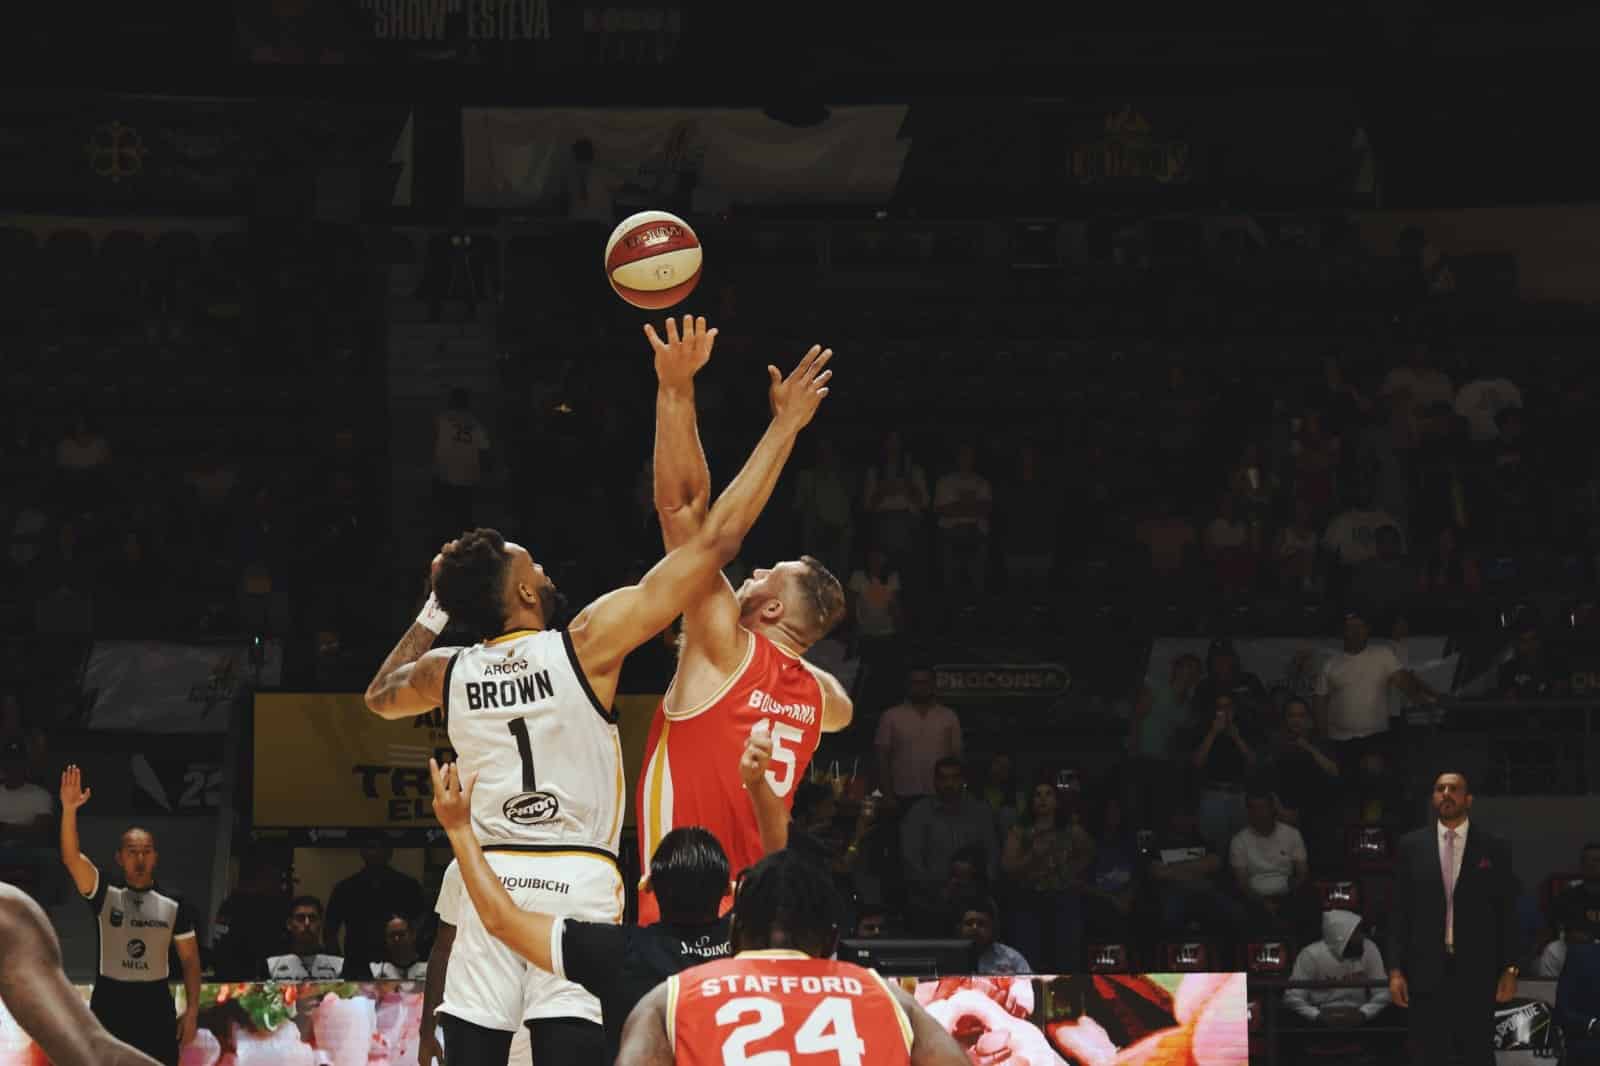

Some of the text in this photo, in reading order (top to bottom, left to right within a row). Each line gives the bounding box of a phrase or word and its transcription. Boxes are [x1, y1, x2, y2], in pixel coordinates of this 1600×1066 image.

[466, 669, 554, 710] BROWN
[508, 716, 536, 792] 1
[701, 975, 863, 997] STAFFORD
[715, 996, 865, 1066] 24
